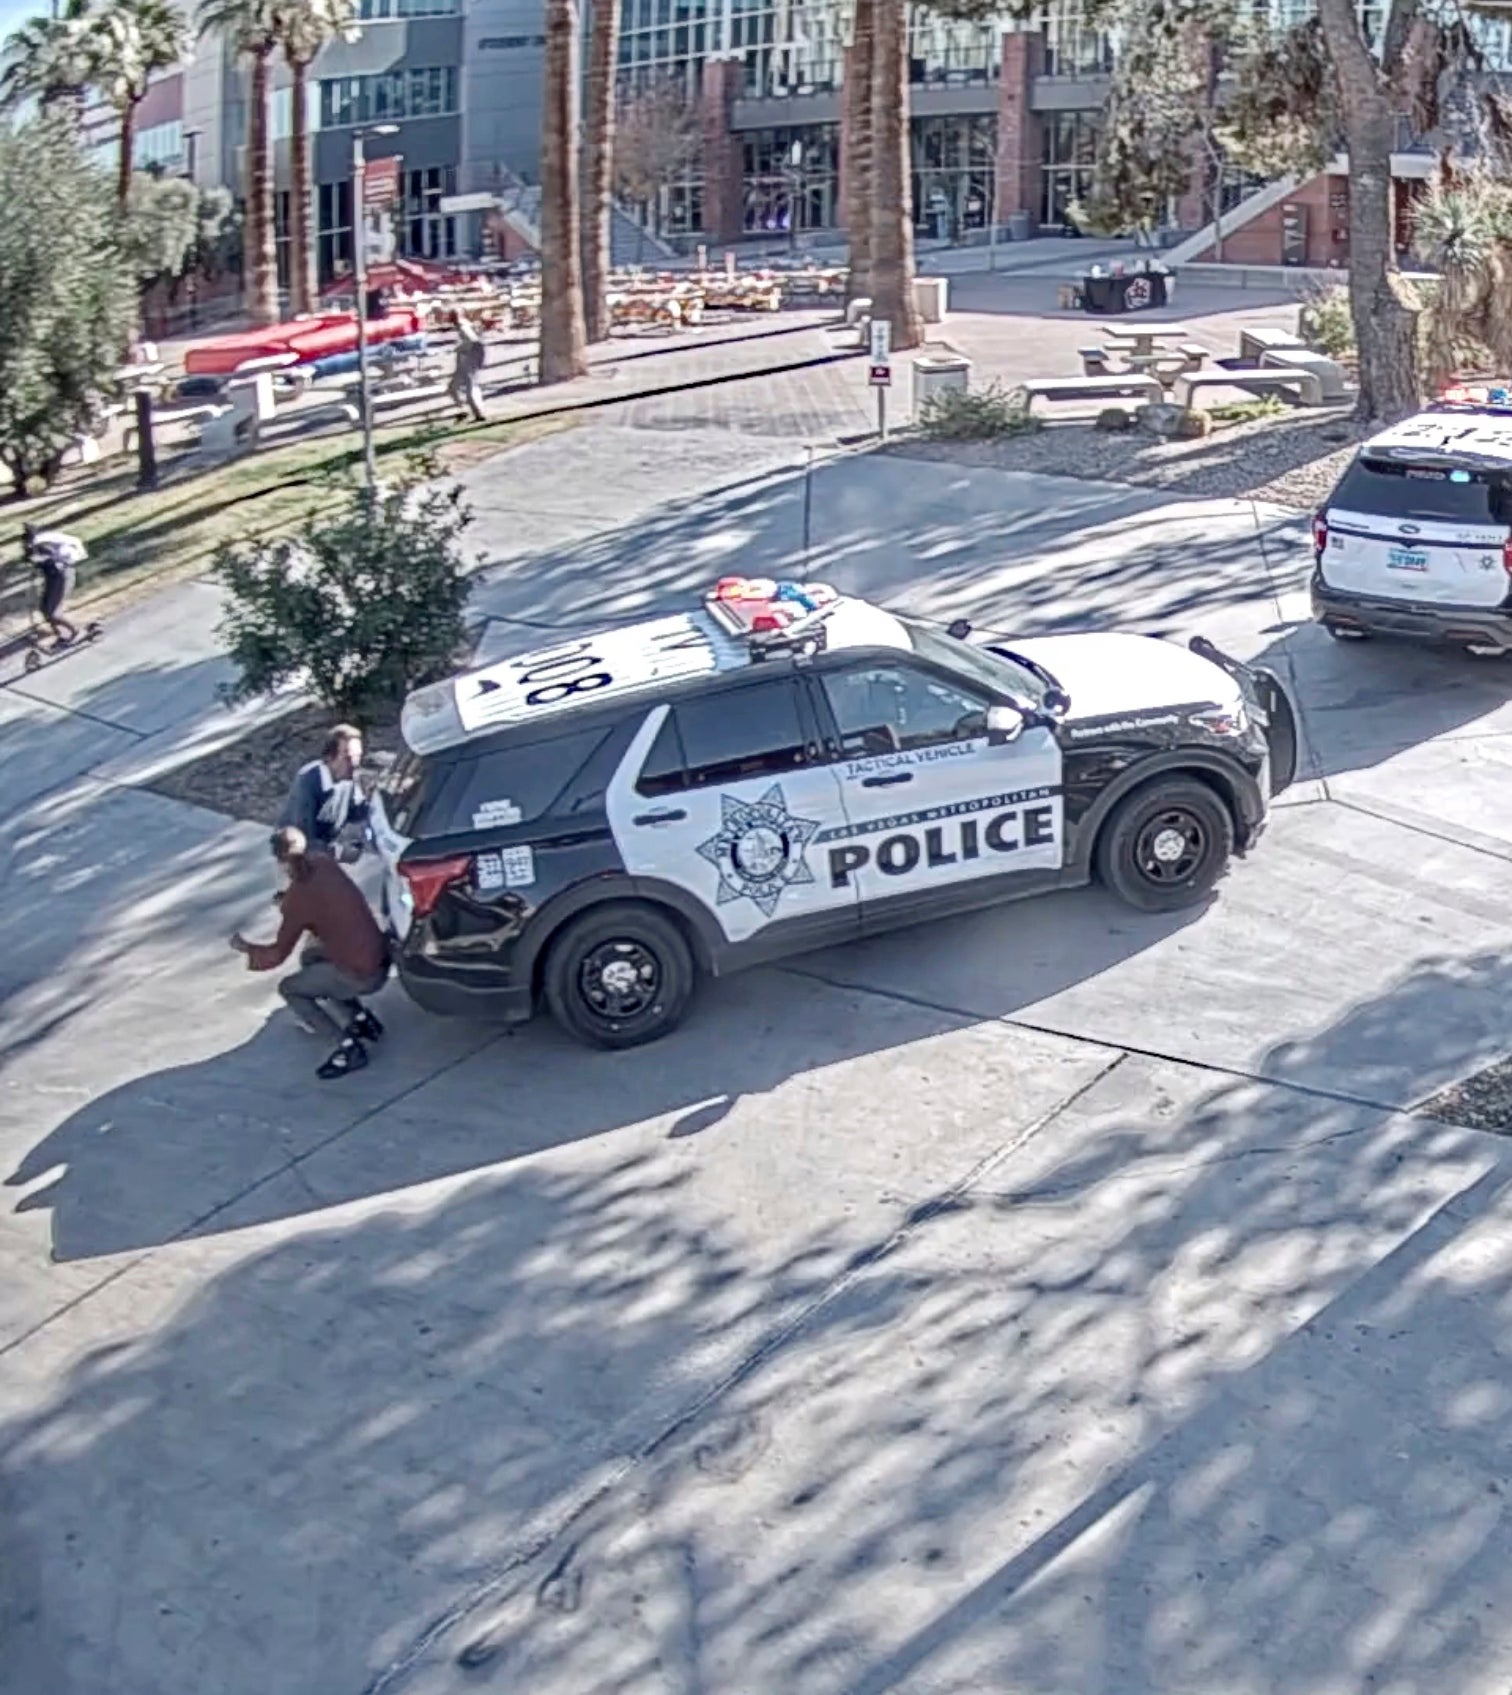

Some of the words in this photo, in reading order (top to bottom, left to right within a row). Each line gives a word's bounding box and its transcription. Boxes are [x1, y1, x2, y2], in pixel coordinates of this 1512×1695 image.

[847, 754, 914, 775] TACTICAL
[916, 743, 976, 762] VEHICLE
[828, 805, 1054, 888] POLICE
